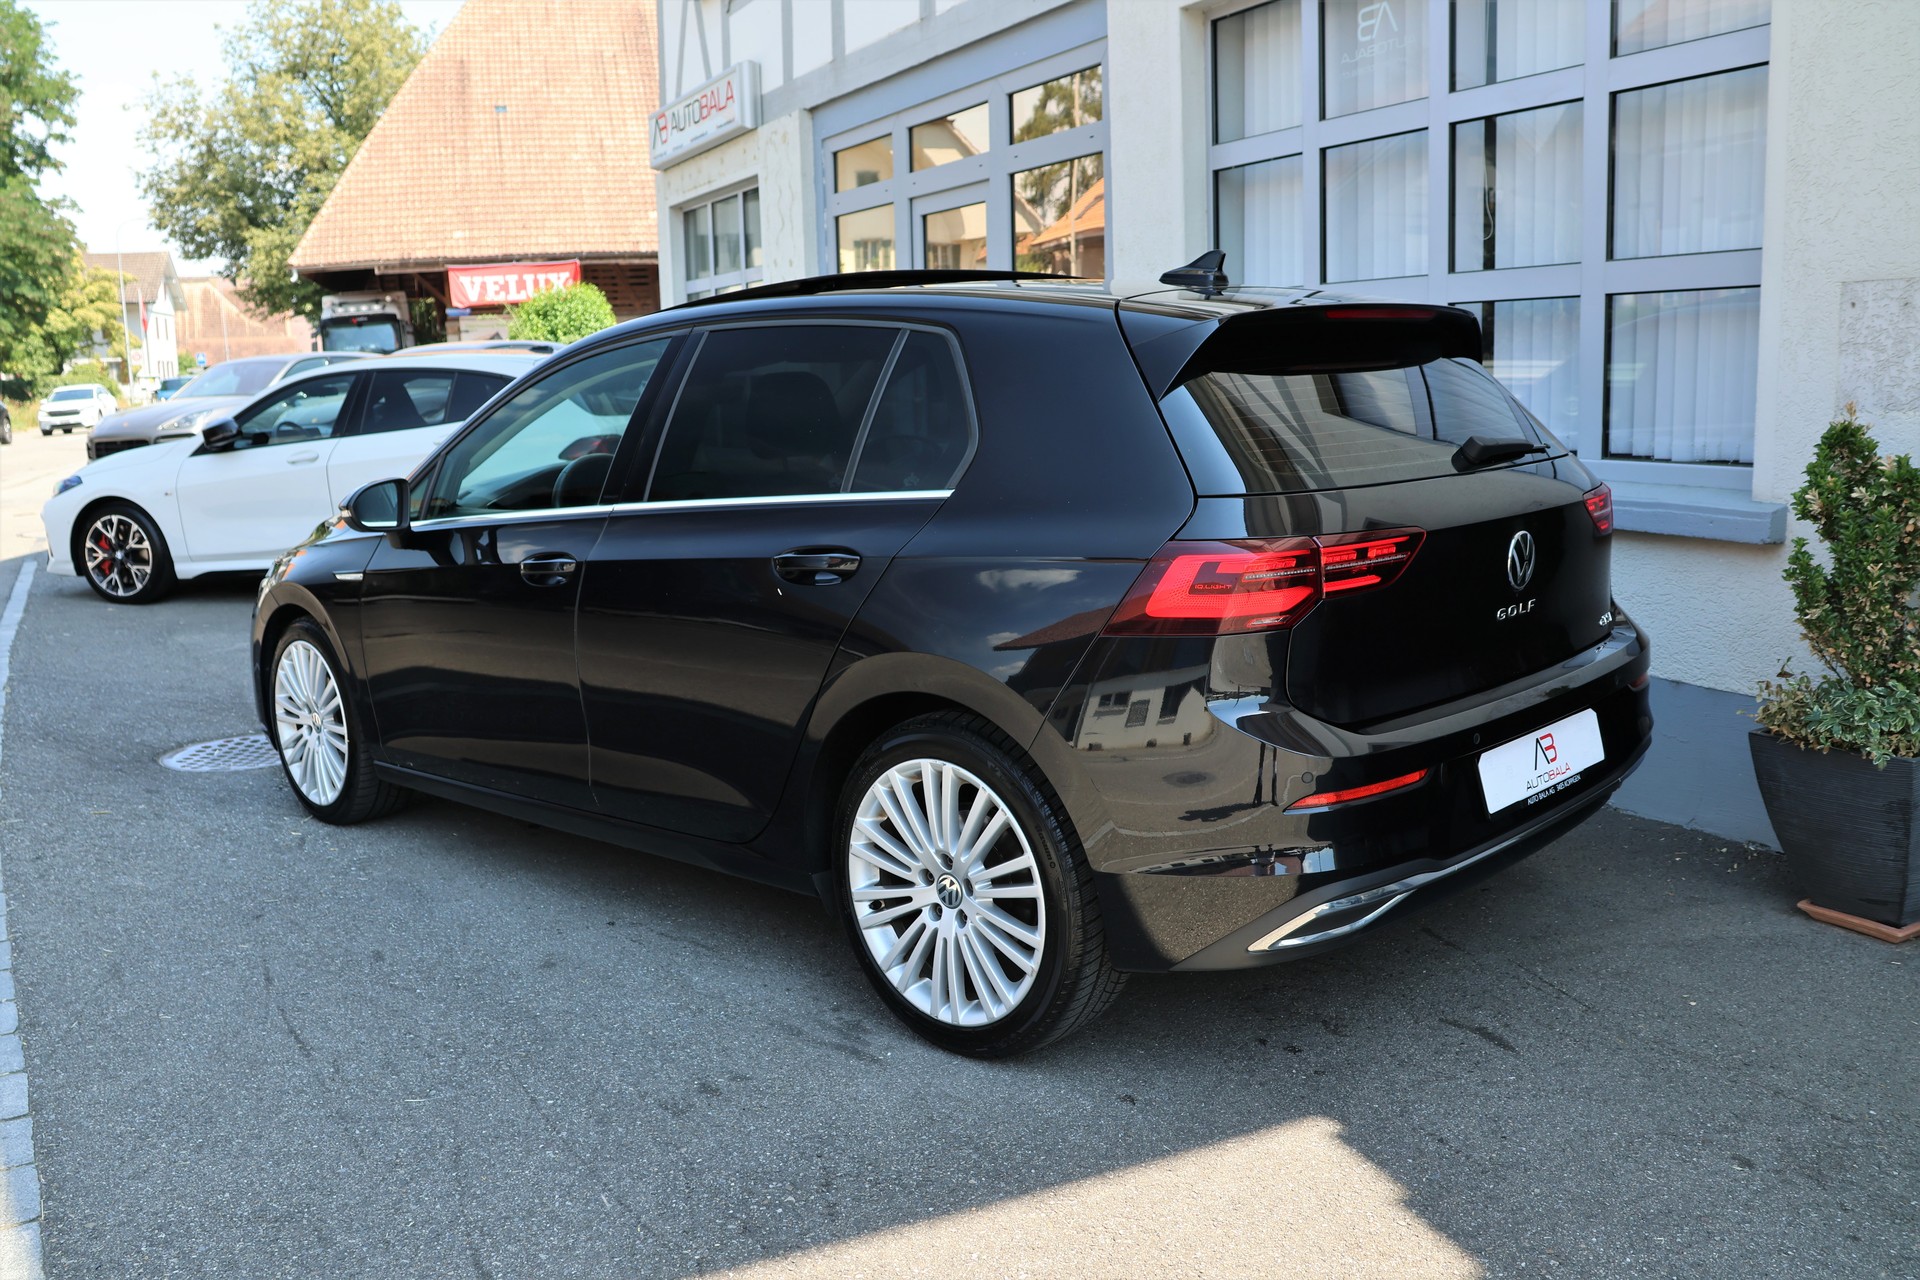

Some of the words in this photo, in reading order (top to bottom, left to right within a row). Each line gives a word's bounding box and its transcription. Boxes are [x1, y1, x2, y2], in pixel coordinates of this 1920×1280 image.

[670, 79, 735, 136] AUTOBALA
[459, 271, 570, 302] VELUX
[1496, 598, 1536, 621] GOLF
[1526, 762, 1571, 791] AUTOBALA
